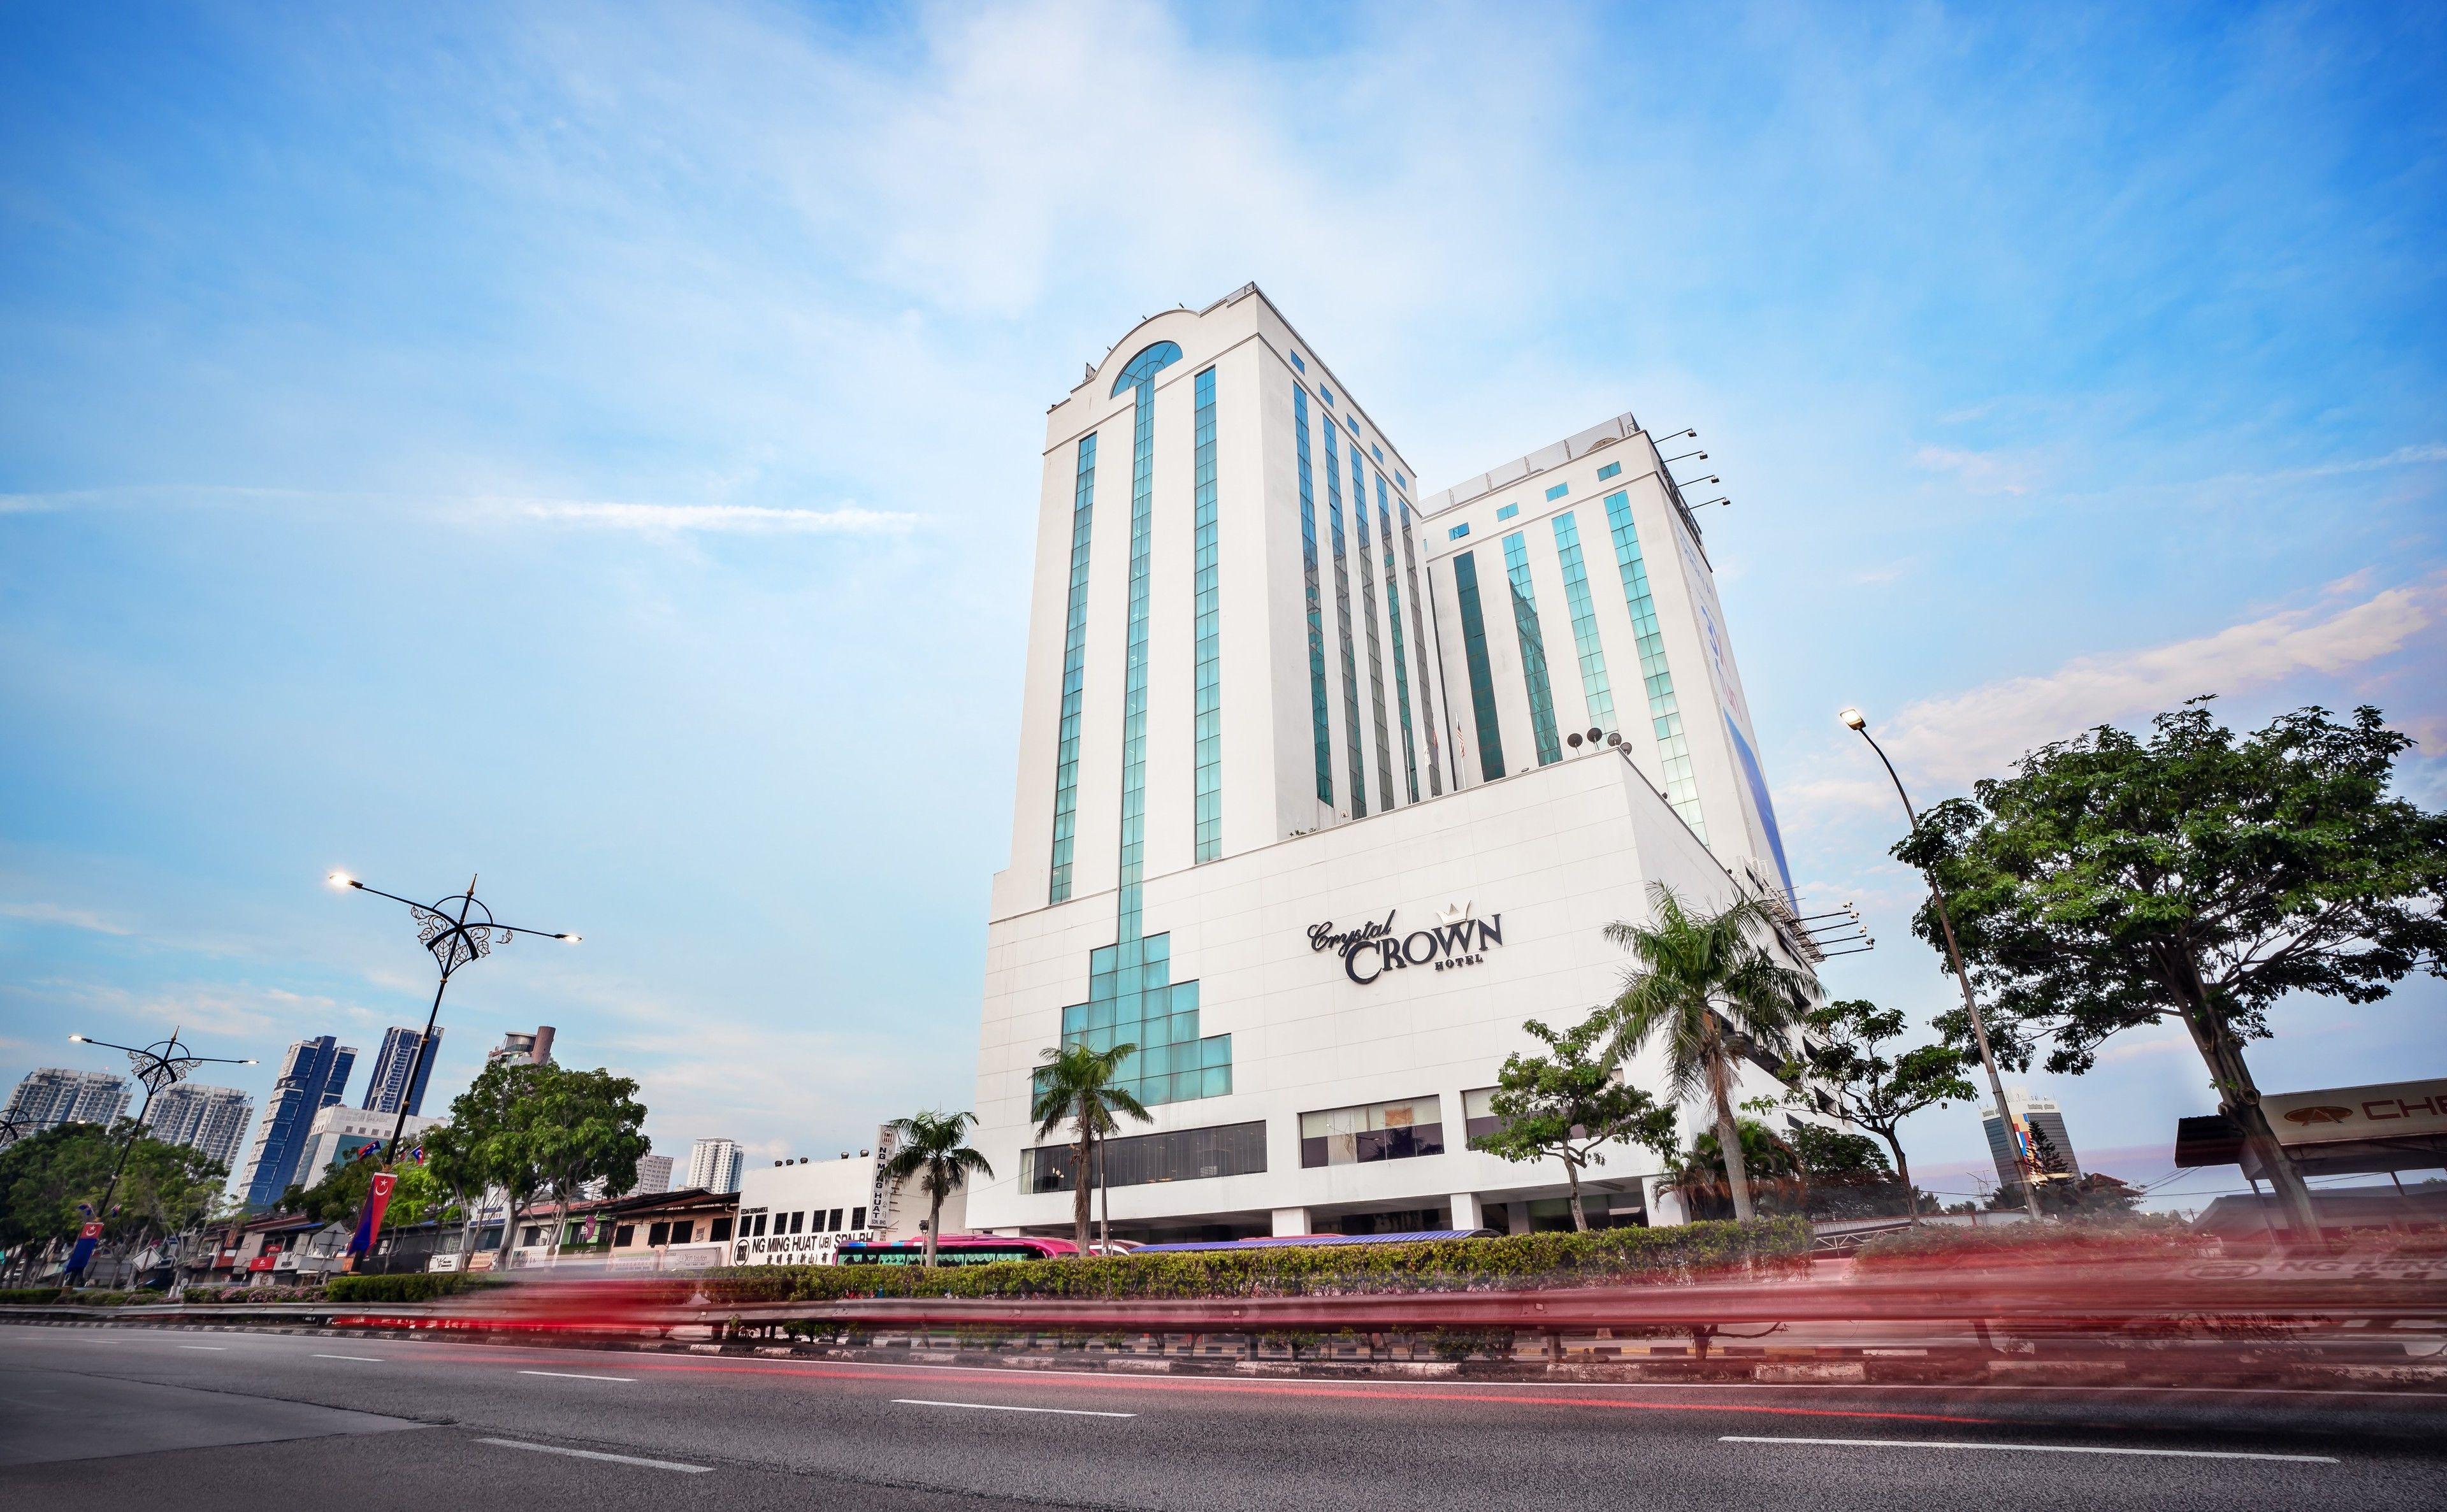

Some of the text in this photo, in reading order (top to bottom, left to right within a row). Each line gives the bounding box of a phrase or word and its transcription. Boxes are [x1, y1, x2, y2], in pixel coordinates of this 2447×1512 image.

[1306, 909, 1396, 958] Crystal
[1345, 913, 1503, 985] CROWN
[1434, 953, 1484, 971] HOTEL
[872, 1146, 887, 1218] NG MNG HUAT
[752, 1238, 766, 1253] NG
[767, 1237, 790, 1253] MING
[791, 1235, 818, 1251] HUAT
[819, 1235, 832, 1249] (JB)
